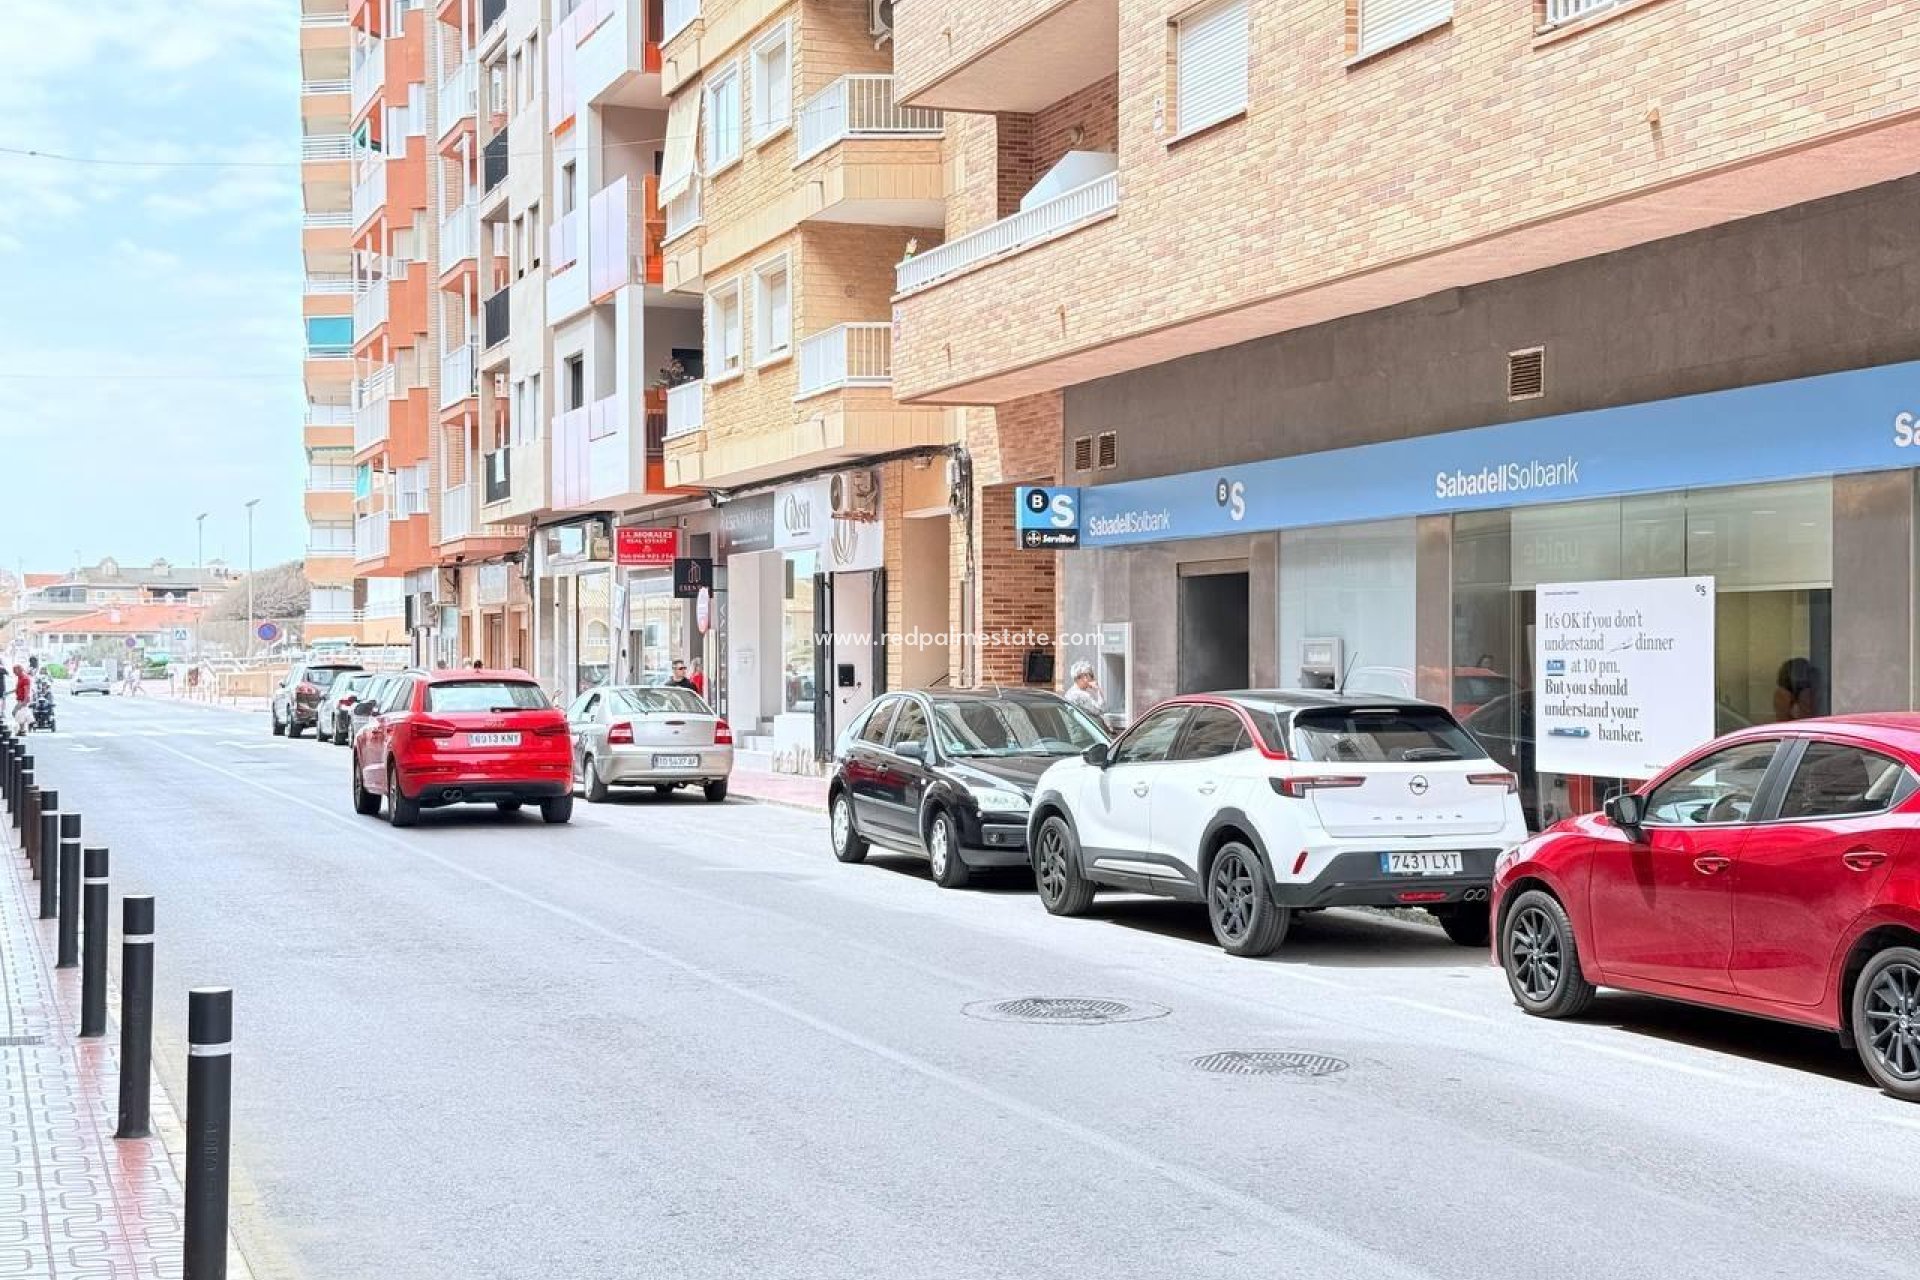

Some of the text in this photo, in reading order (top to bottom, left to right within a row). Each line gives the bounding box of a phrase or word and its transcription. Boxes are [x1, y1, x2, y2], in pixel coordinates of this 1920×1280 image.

[1435, 456, 1579, 499] SabadellSolbank
[1089, 507, 1171, 536] SabadellSolbank
[1544, 609, 1642, 632] It's OK if you don't
[1544, 632, 1675, 651] understand dinner
[1571, 658, 1621, 678] at 10 pm.
[1544, 678, 1628, 699] But you should
[1544, 700, 1639, 723] understand your
[1598, 724, 1644, 743] banker.
[1391, 854, 1459, 869] 7431 LXT
